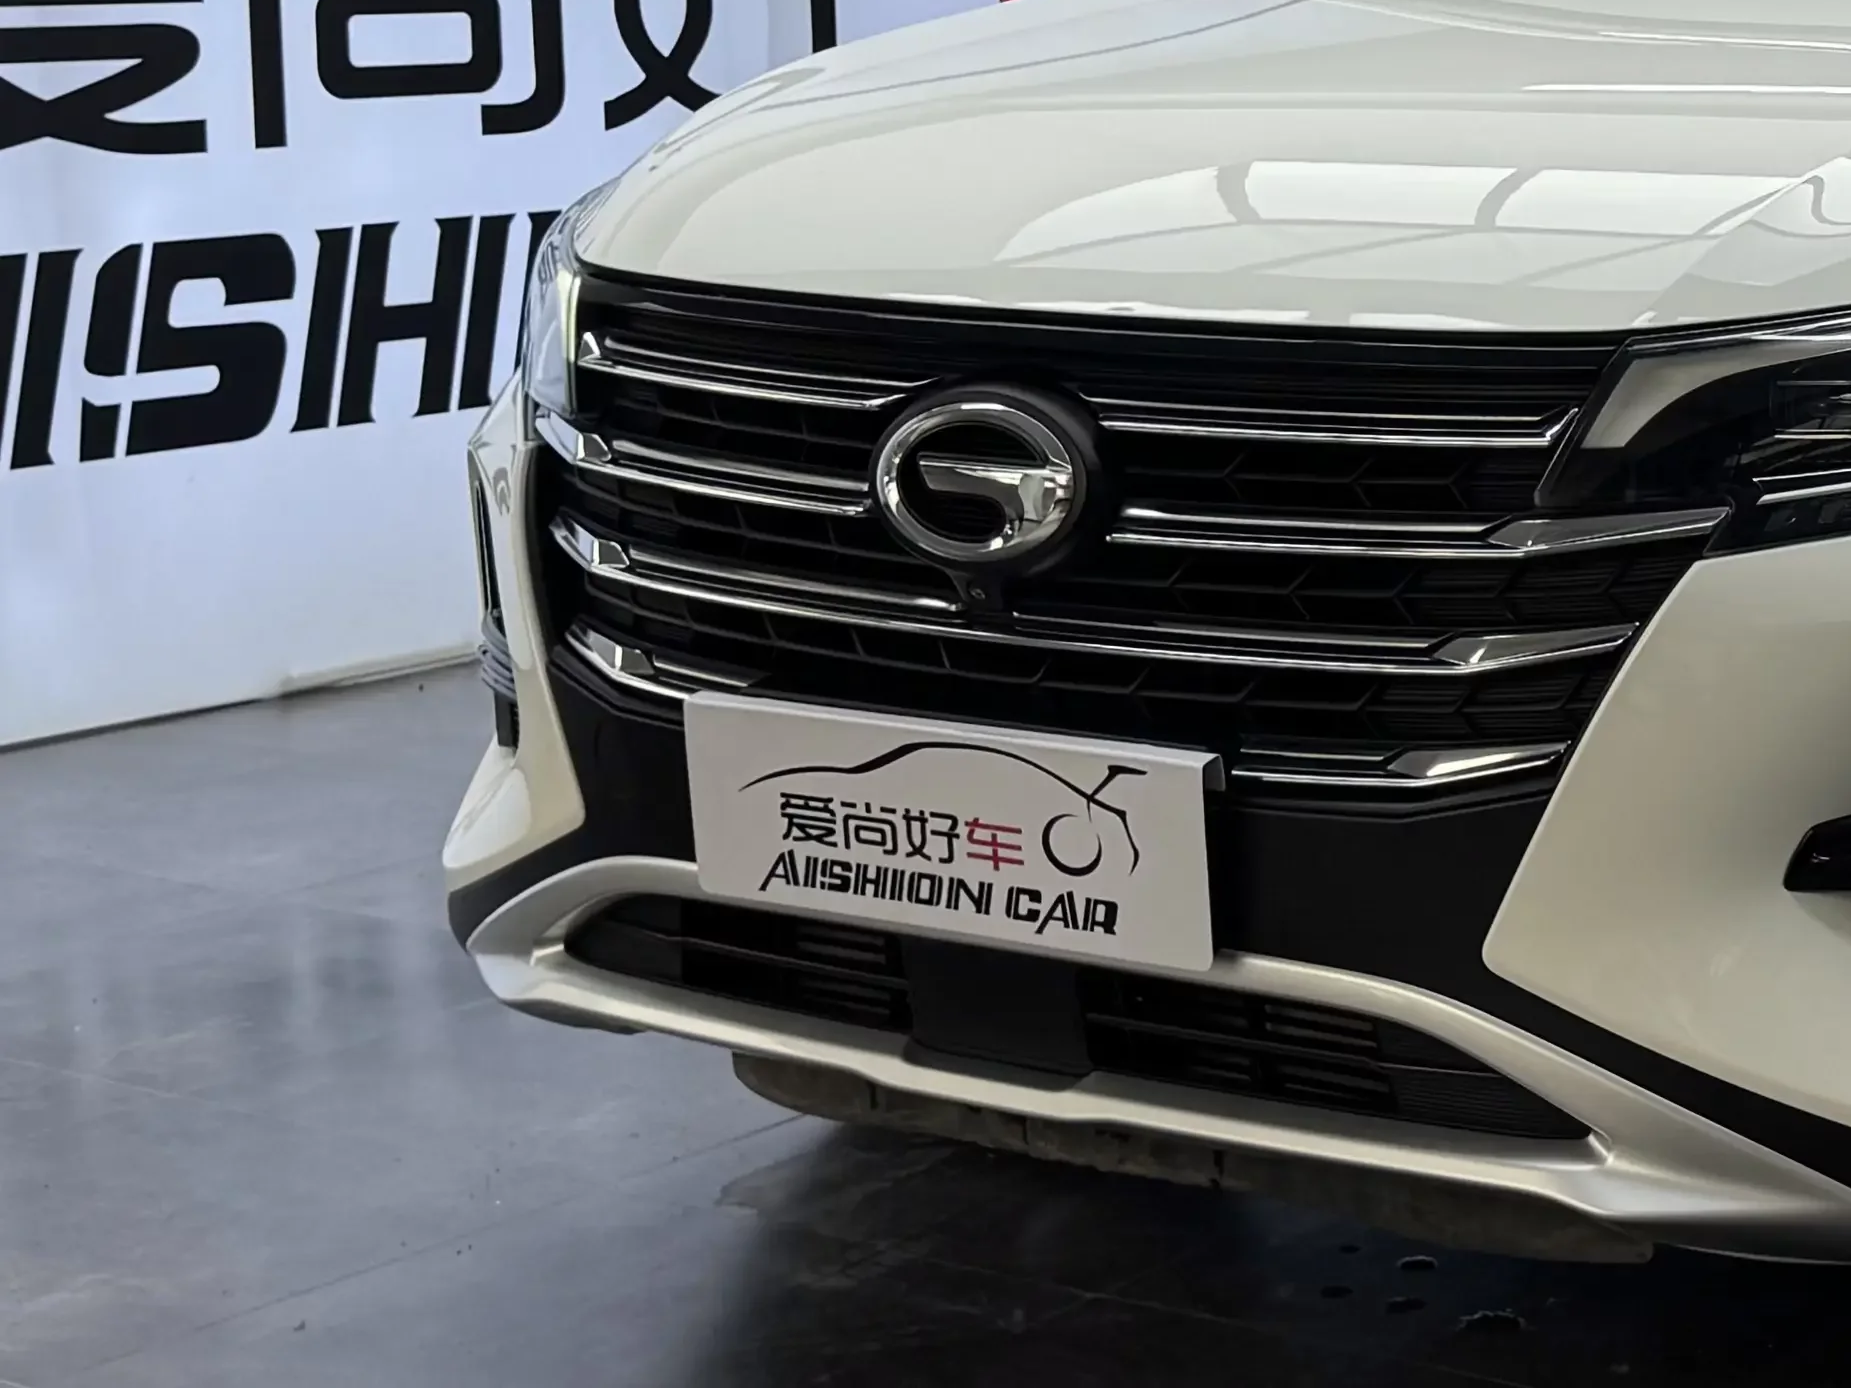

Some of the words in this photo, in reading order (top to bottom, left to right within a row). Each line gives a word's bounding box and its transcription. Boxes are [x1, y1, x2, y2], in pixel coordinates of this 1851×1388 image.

[780, 792, 1025, 872] 爱尚好车
[759, 849, 993, 916] AISHION
[1005, 885, 1119, 936] CAR
